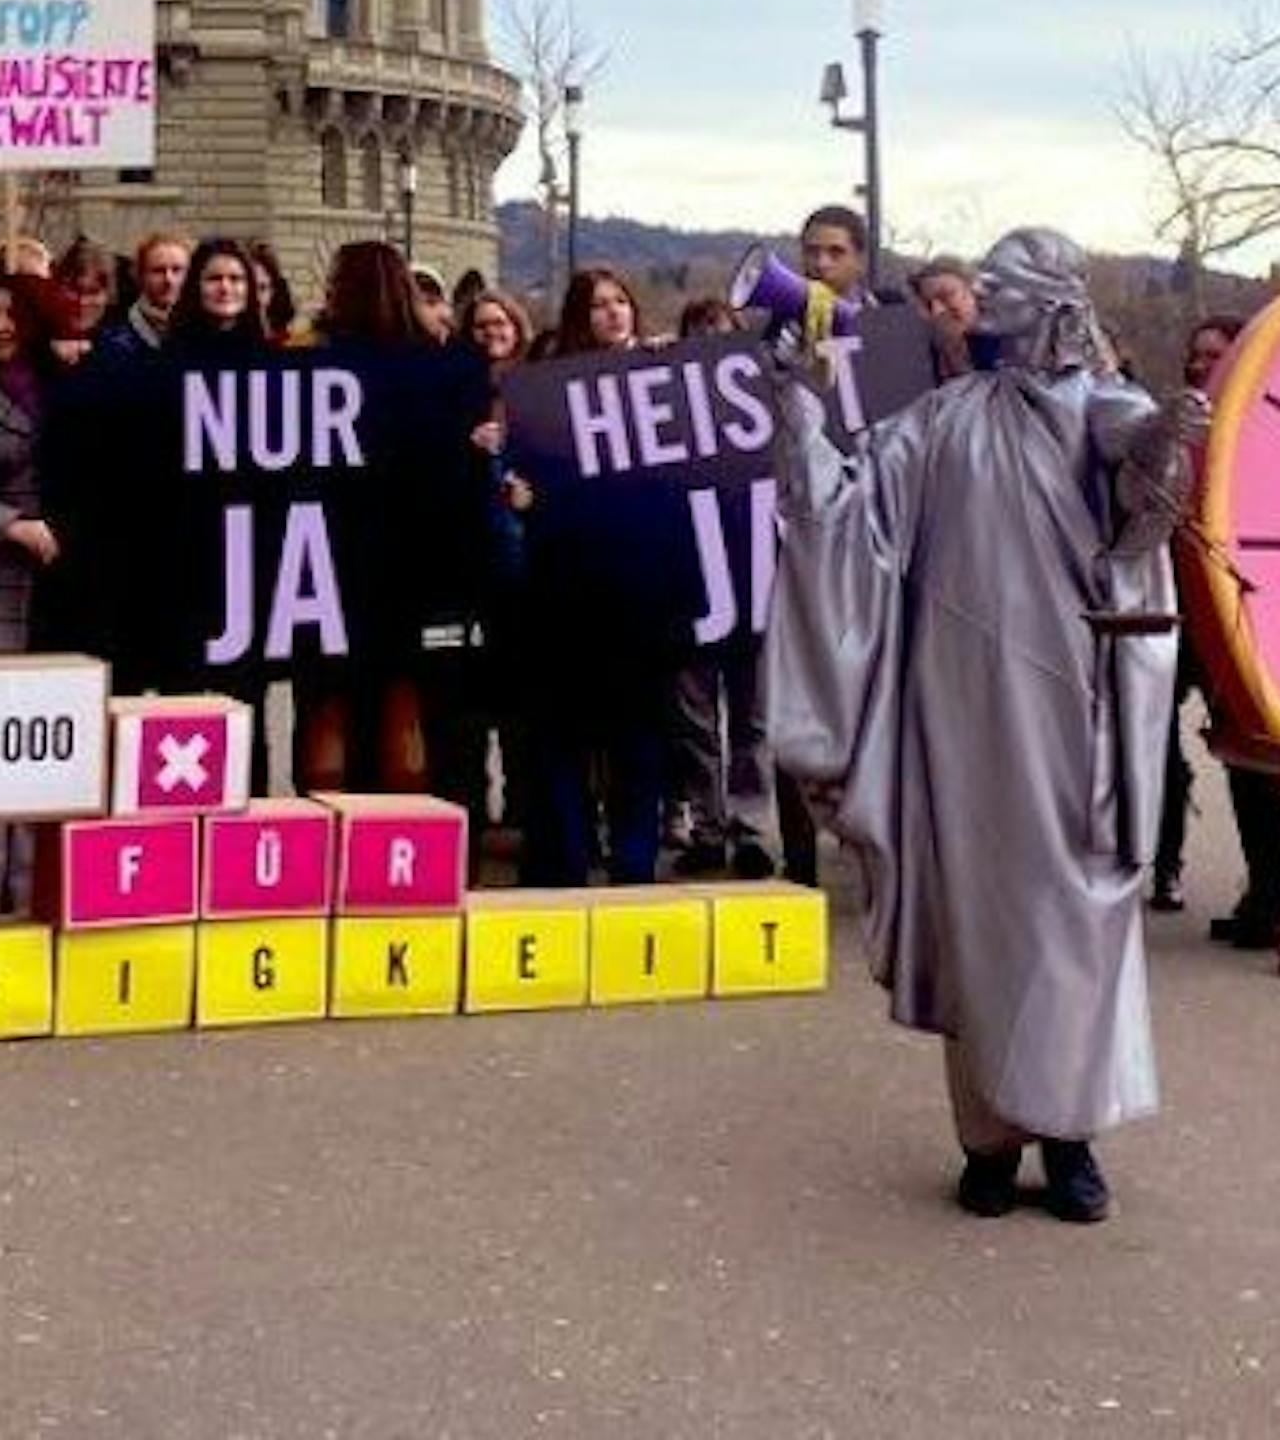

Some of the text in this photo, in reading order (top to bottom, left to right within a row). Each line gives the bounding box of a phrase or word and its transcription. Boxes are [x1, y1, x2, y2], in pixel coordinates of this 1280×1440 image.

[184, 368, 364, 472] NUR
[566, 335, 871, 477] HEIST
[206, 502, 349, 665] JA
